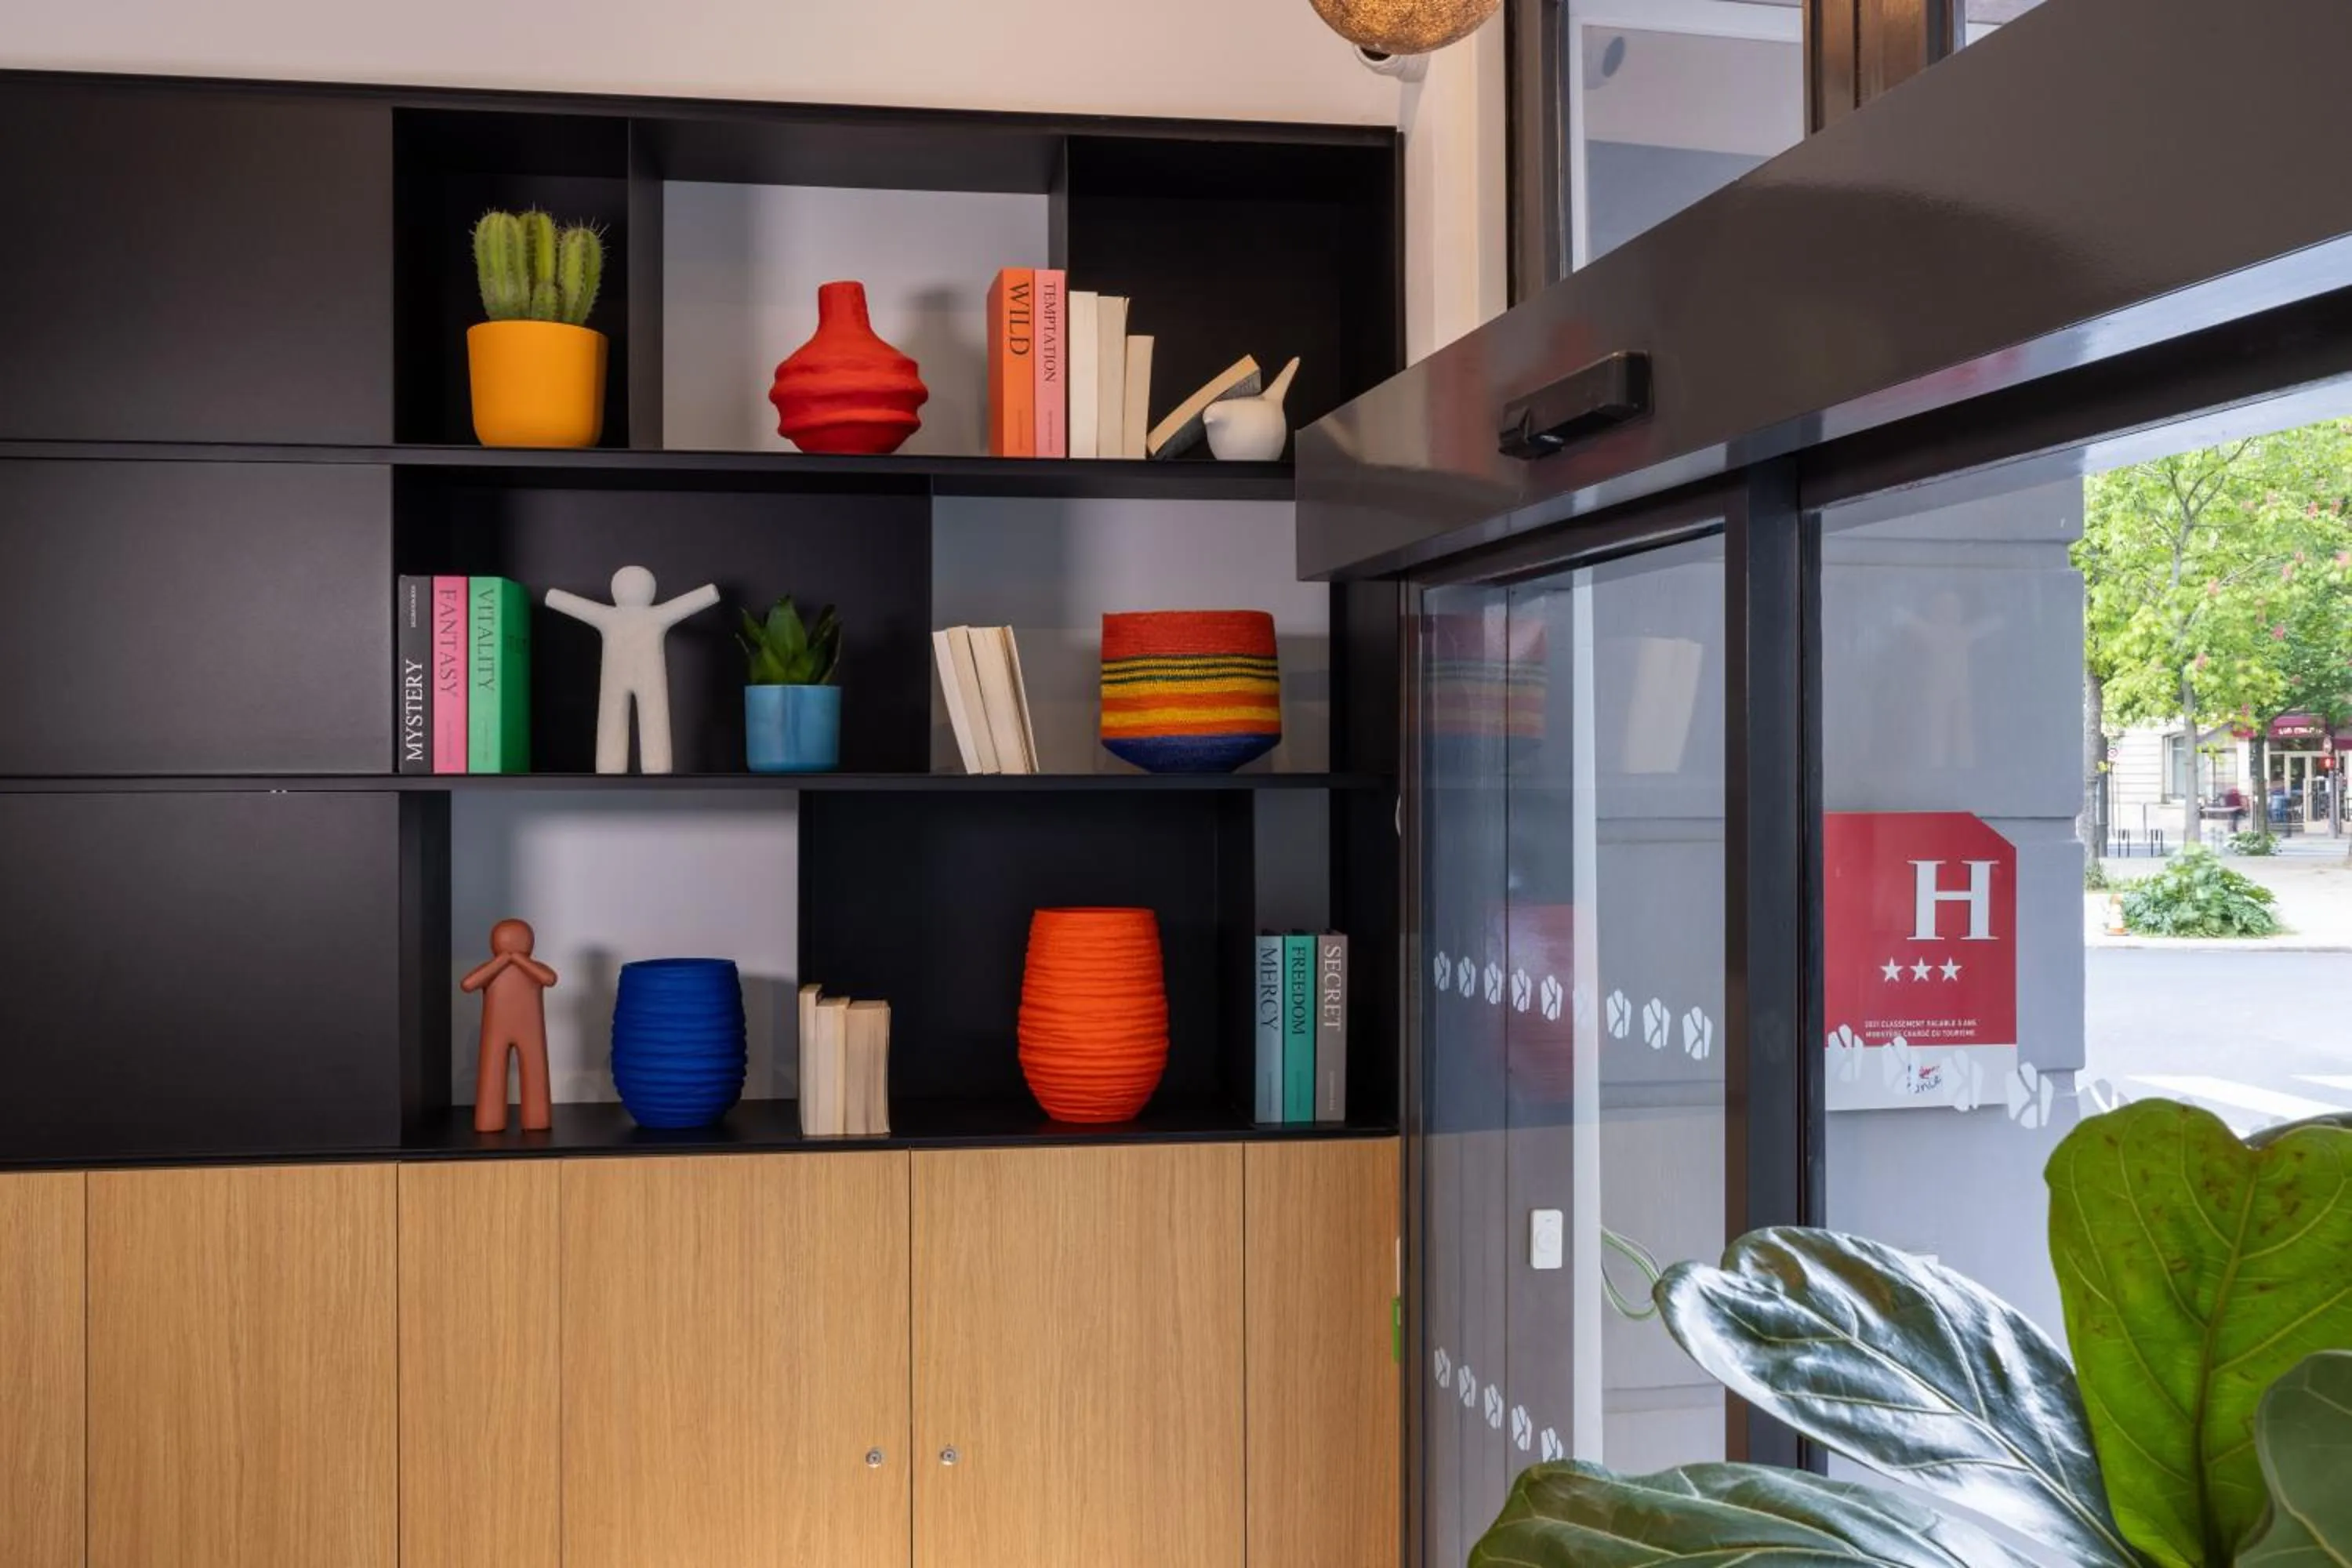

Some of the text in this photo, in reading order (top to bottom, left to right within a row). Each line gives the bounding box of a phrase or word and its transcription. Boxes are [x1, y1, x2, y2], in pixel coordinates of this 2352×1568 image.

[1009, 281, 1029, 356] WILD
[1044, 281, 1057, 383] TEMPTATION
[439, 590, 458, 698] FANTASY
[477, 589, 495, 691] VITALITY
[405, 659, 423, 761] MYSTERY
[1907, 859, 2000, 940] H
[1260, 946, 1279, 1031] MERCY
[1291, 946, 1306, 1035] FREEDOM
[1323, 945, 1342, 1032] SECRET
